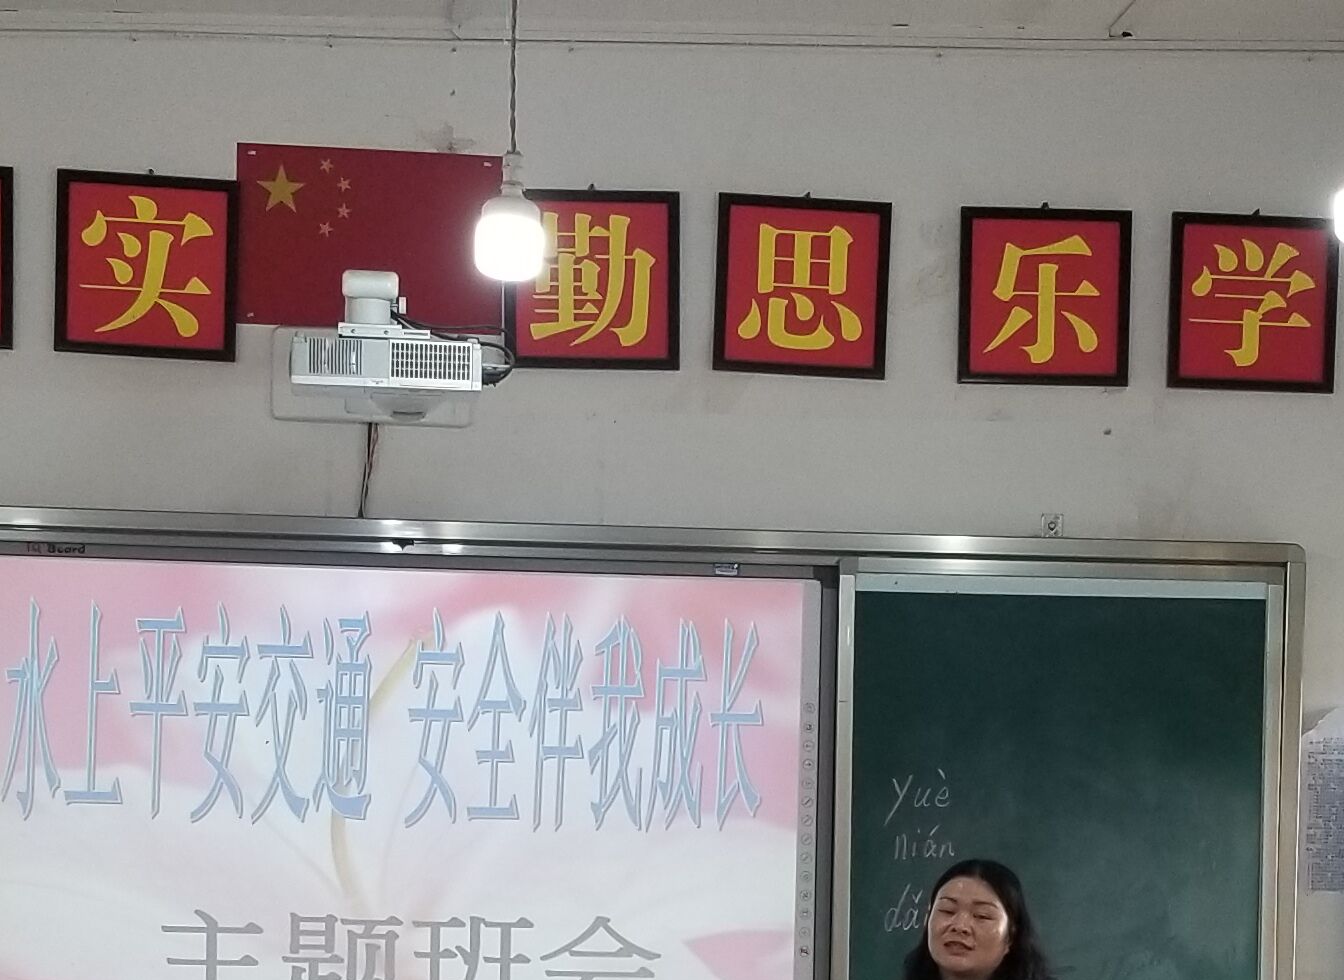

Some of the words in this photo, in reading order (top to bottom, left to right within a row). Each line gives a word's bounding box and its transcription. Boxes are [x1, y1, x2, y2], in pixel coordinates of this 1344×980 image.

[78, 195, 214, 339] 实
[530, 212, 659, 348] 勤
[737, 222, 862, 352] 思
[982, 235, 1102, 366] 乐
[1188, 237, 1317, 368] 学
[47, 543, 86, 554] Board
[1, 596, 378, 824] 水上平安交通
[404, 606, 766, 833] 安全伴我成长
[883, 768, 952, 827] yuè
[893, 824, 957, 861] nián
